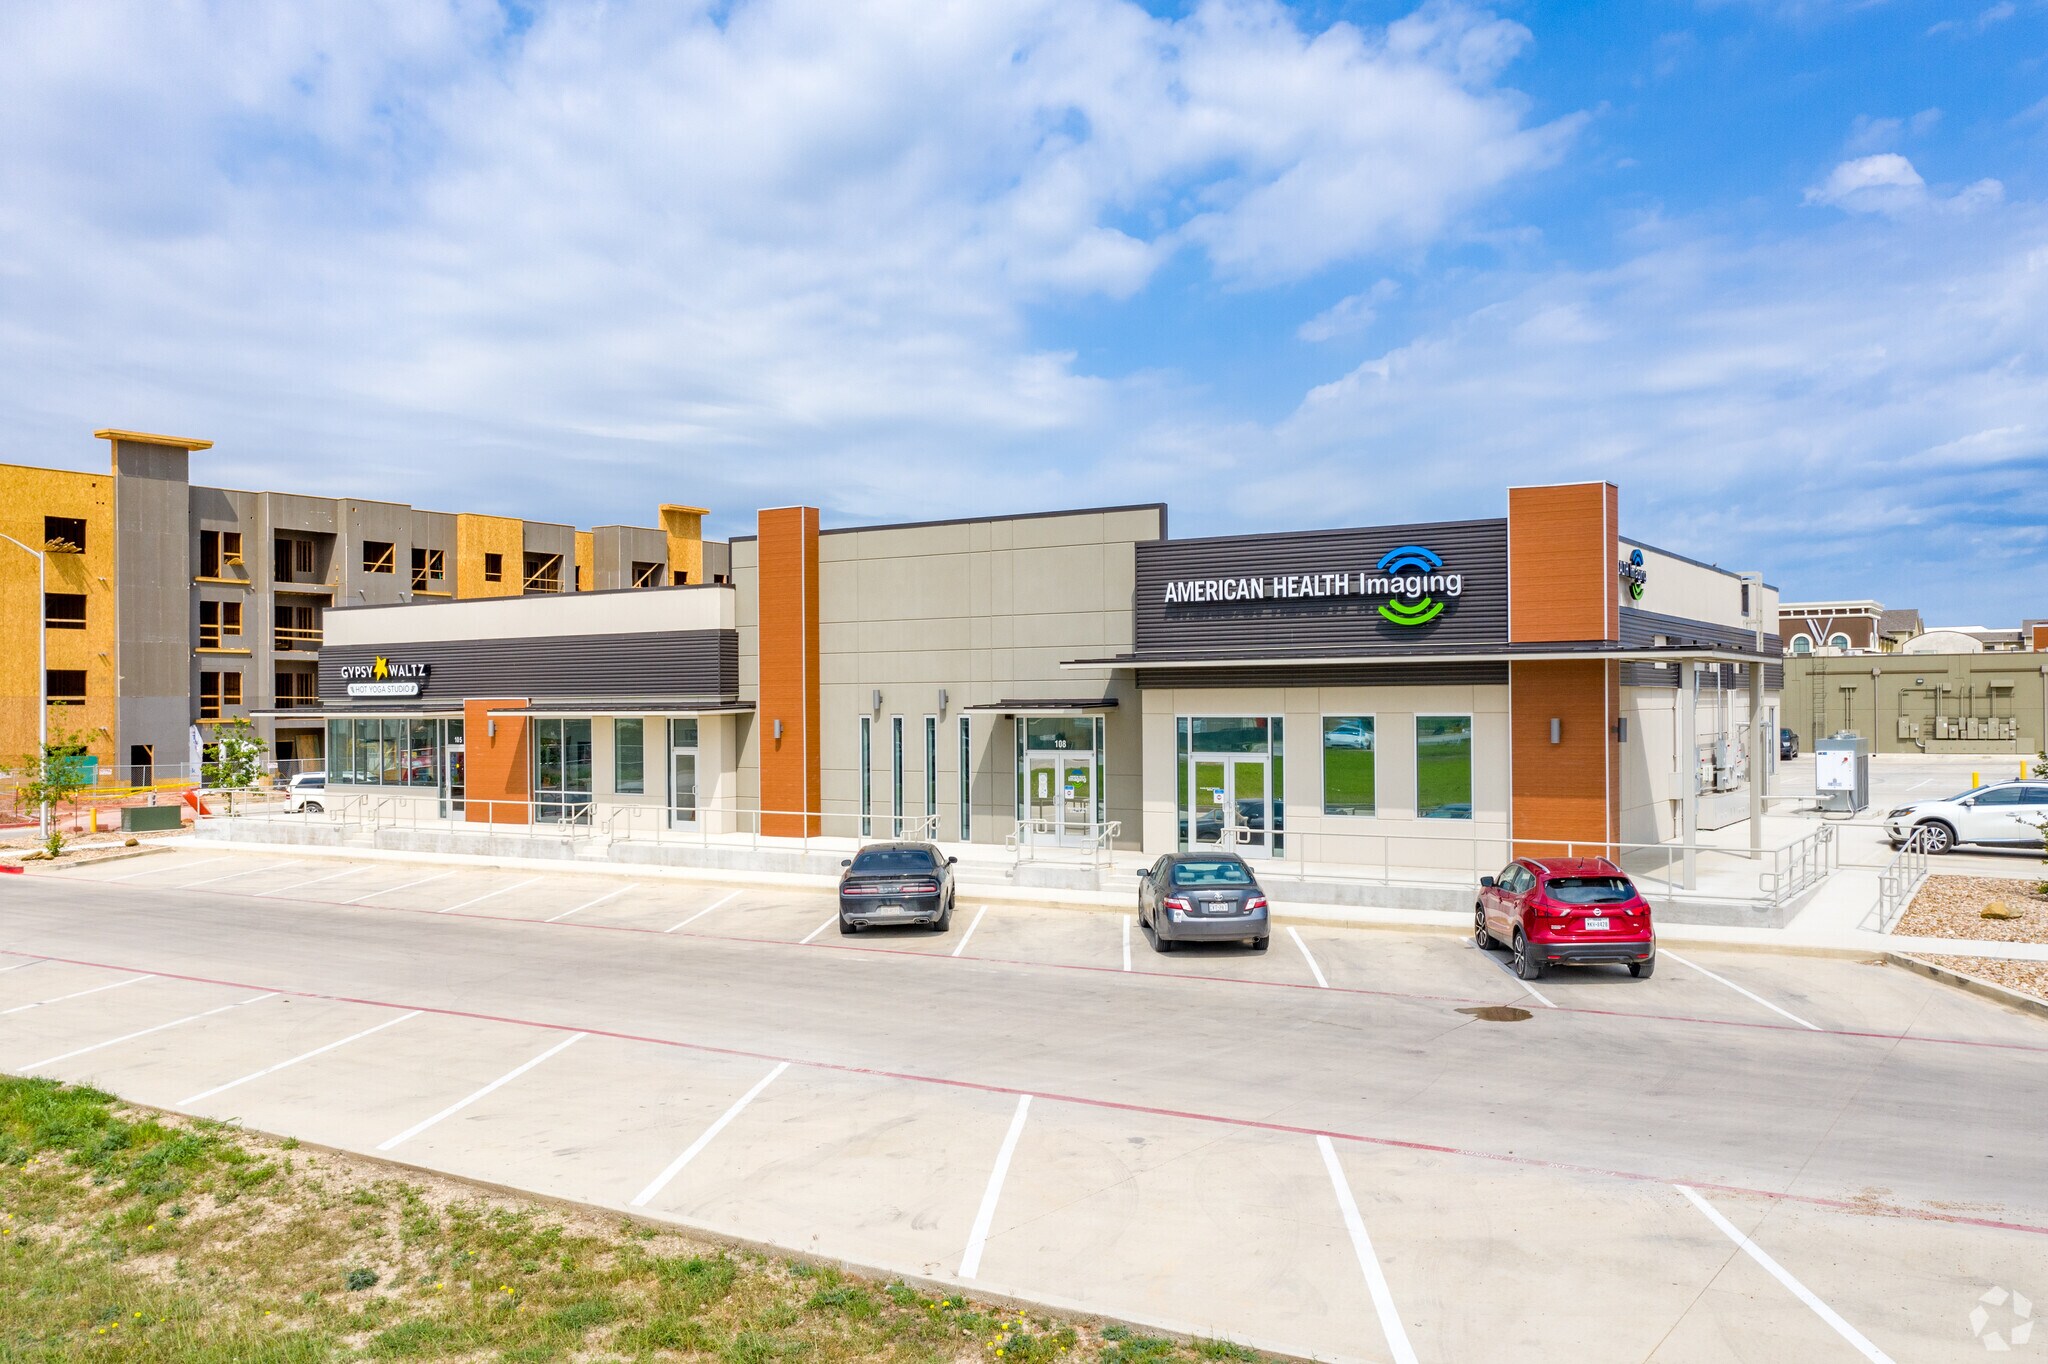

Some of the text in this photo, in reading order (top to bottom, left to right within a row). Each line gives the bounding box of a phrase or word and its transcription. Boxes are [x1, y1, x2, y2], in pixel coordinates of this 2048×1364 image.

[1164, 572, 1462, 603] AMERICAN HEALTH Imaging
[341, 664, 426, 678] GYPSY WALTZ
[369, 685, 385, 693] YOGA
[387, 685, 410, 693] STUDIO
[1055, 740, 1067, 748] 108
